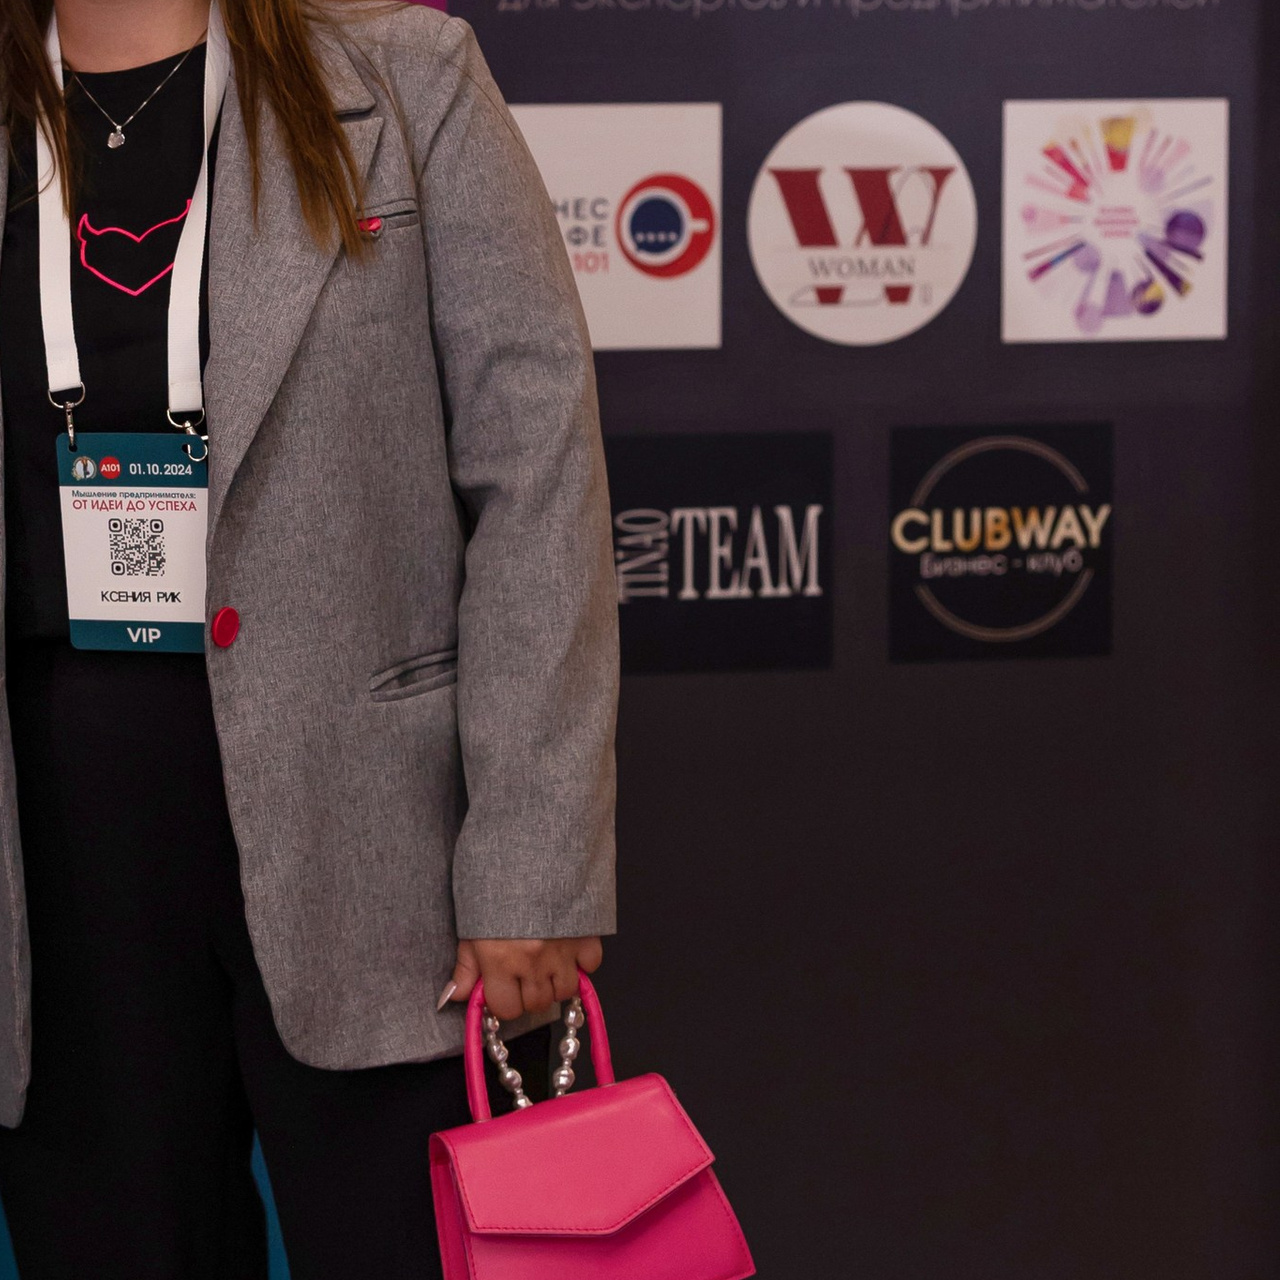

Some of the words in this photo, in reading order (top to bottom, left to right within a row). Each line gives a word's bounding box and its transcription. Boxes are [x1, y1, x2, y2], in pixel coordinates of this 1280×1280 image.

[807, 258, 916, 277] WOMAN
[100, 461, 121, 473] A101
[129, 463, 193, 476] 01.10.2024
[71, 490, 118, 499] Мышление
[119, 491, 197, 500] предпринимателя:
[72, 499, 88, 510] ОТ
[91, 499, 123, 512] ИДЕИ
[126, 500, 146, 512] ДО
[148, 500, 197, 512] УСПЕХА
[890, 504, 1112, 554] CLUBWAY
[671, 504, 824, 600] TEAM
[101, 590, 152, 603] КСЕНИЯ
[156, 591, 182, 603] РИК
[126, 627, 162, 643] VIP
